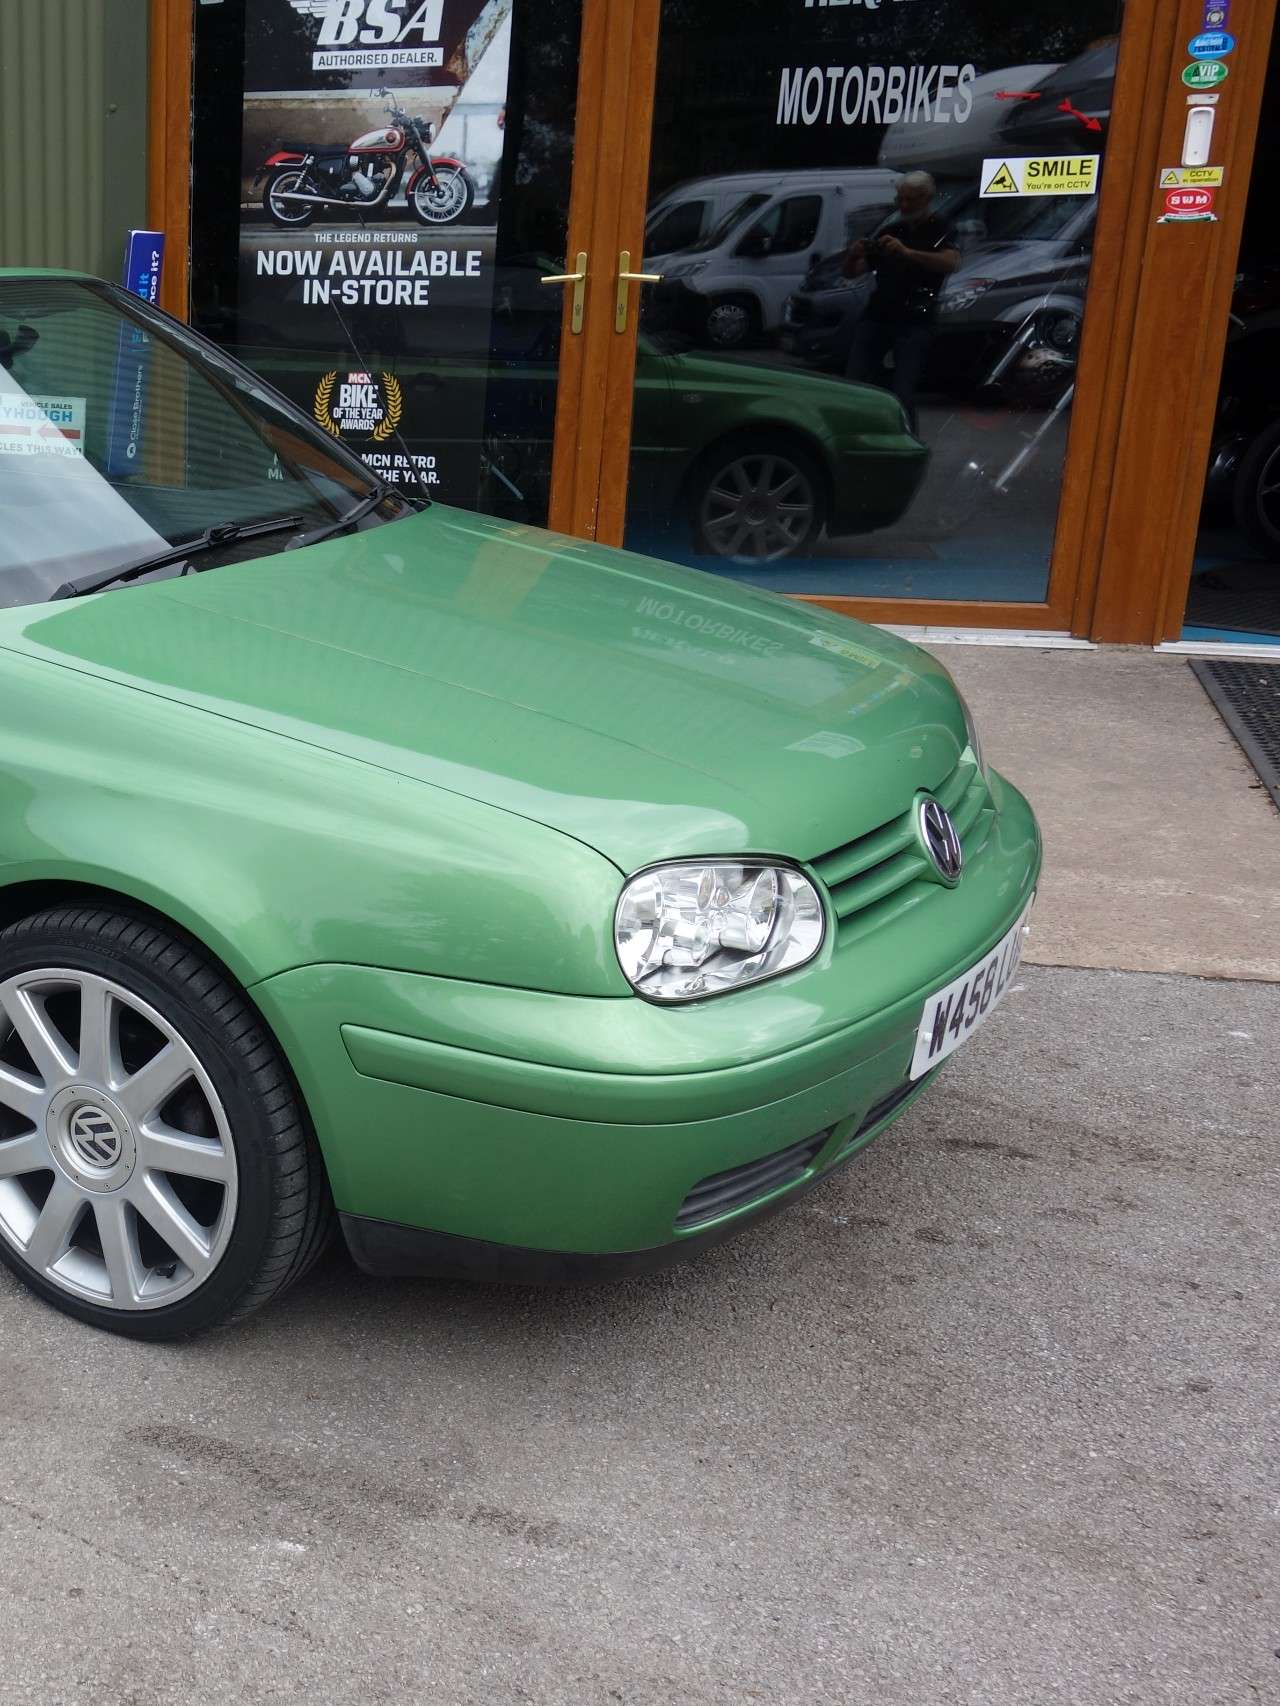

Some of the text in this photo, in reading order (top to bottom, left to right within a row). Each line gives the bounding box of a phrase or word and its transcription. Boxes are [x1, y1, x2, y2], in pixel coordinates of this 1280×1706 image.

[317, 0, 444, 46] BSA
[318, 52, 438, 67] AUTHORISED DEALER.
[776, 63, 976, 125] MOTORBIKES
[1027, 159, 1093, 177] SMILE
[1026, 182, 1052, 190] You're
[1067, 180, 1091, 189] CCTV
[315, 233, 418, 243] THE LEGEND RETURNS
[256, 250, 482, 277] NOW AVAILABLE
[303, 279, 430, 305] IN-STORE
[339, 384, 379, 408] BIKE
[333, 407, 383, 420] OF THE YEAR
[340, 419, 375, 431] AWARDS
[27, 443, 53, 454] THIS
[361, 453, 391, 467] MCN
